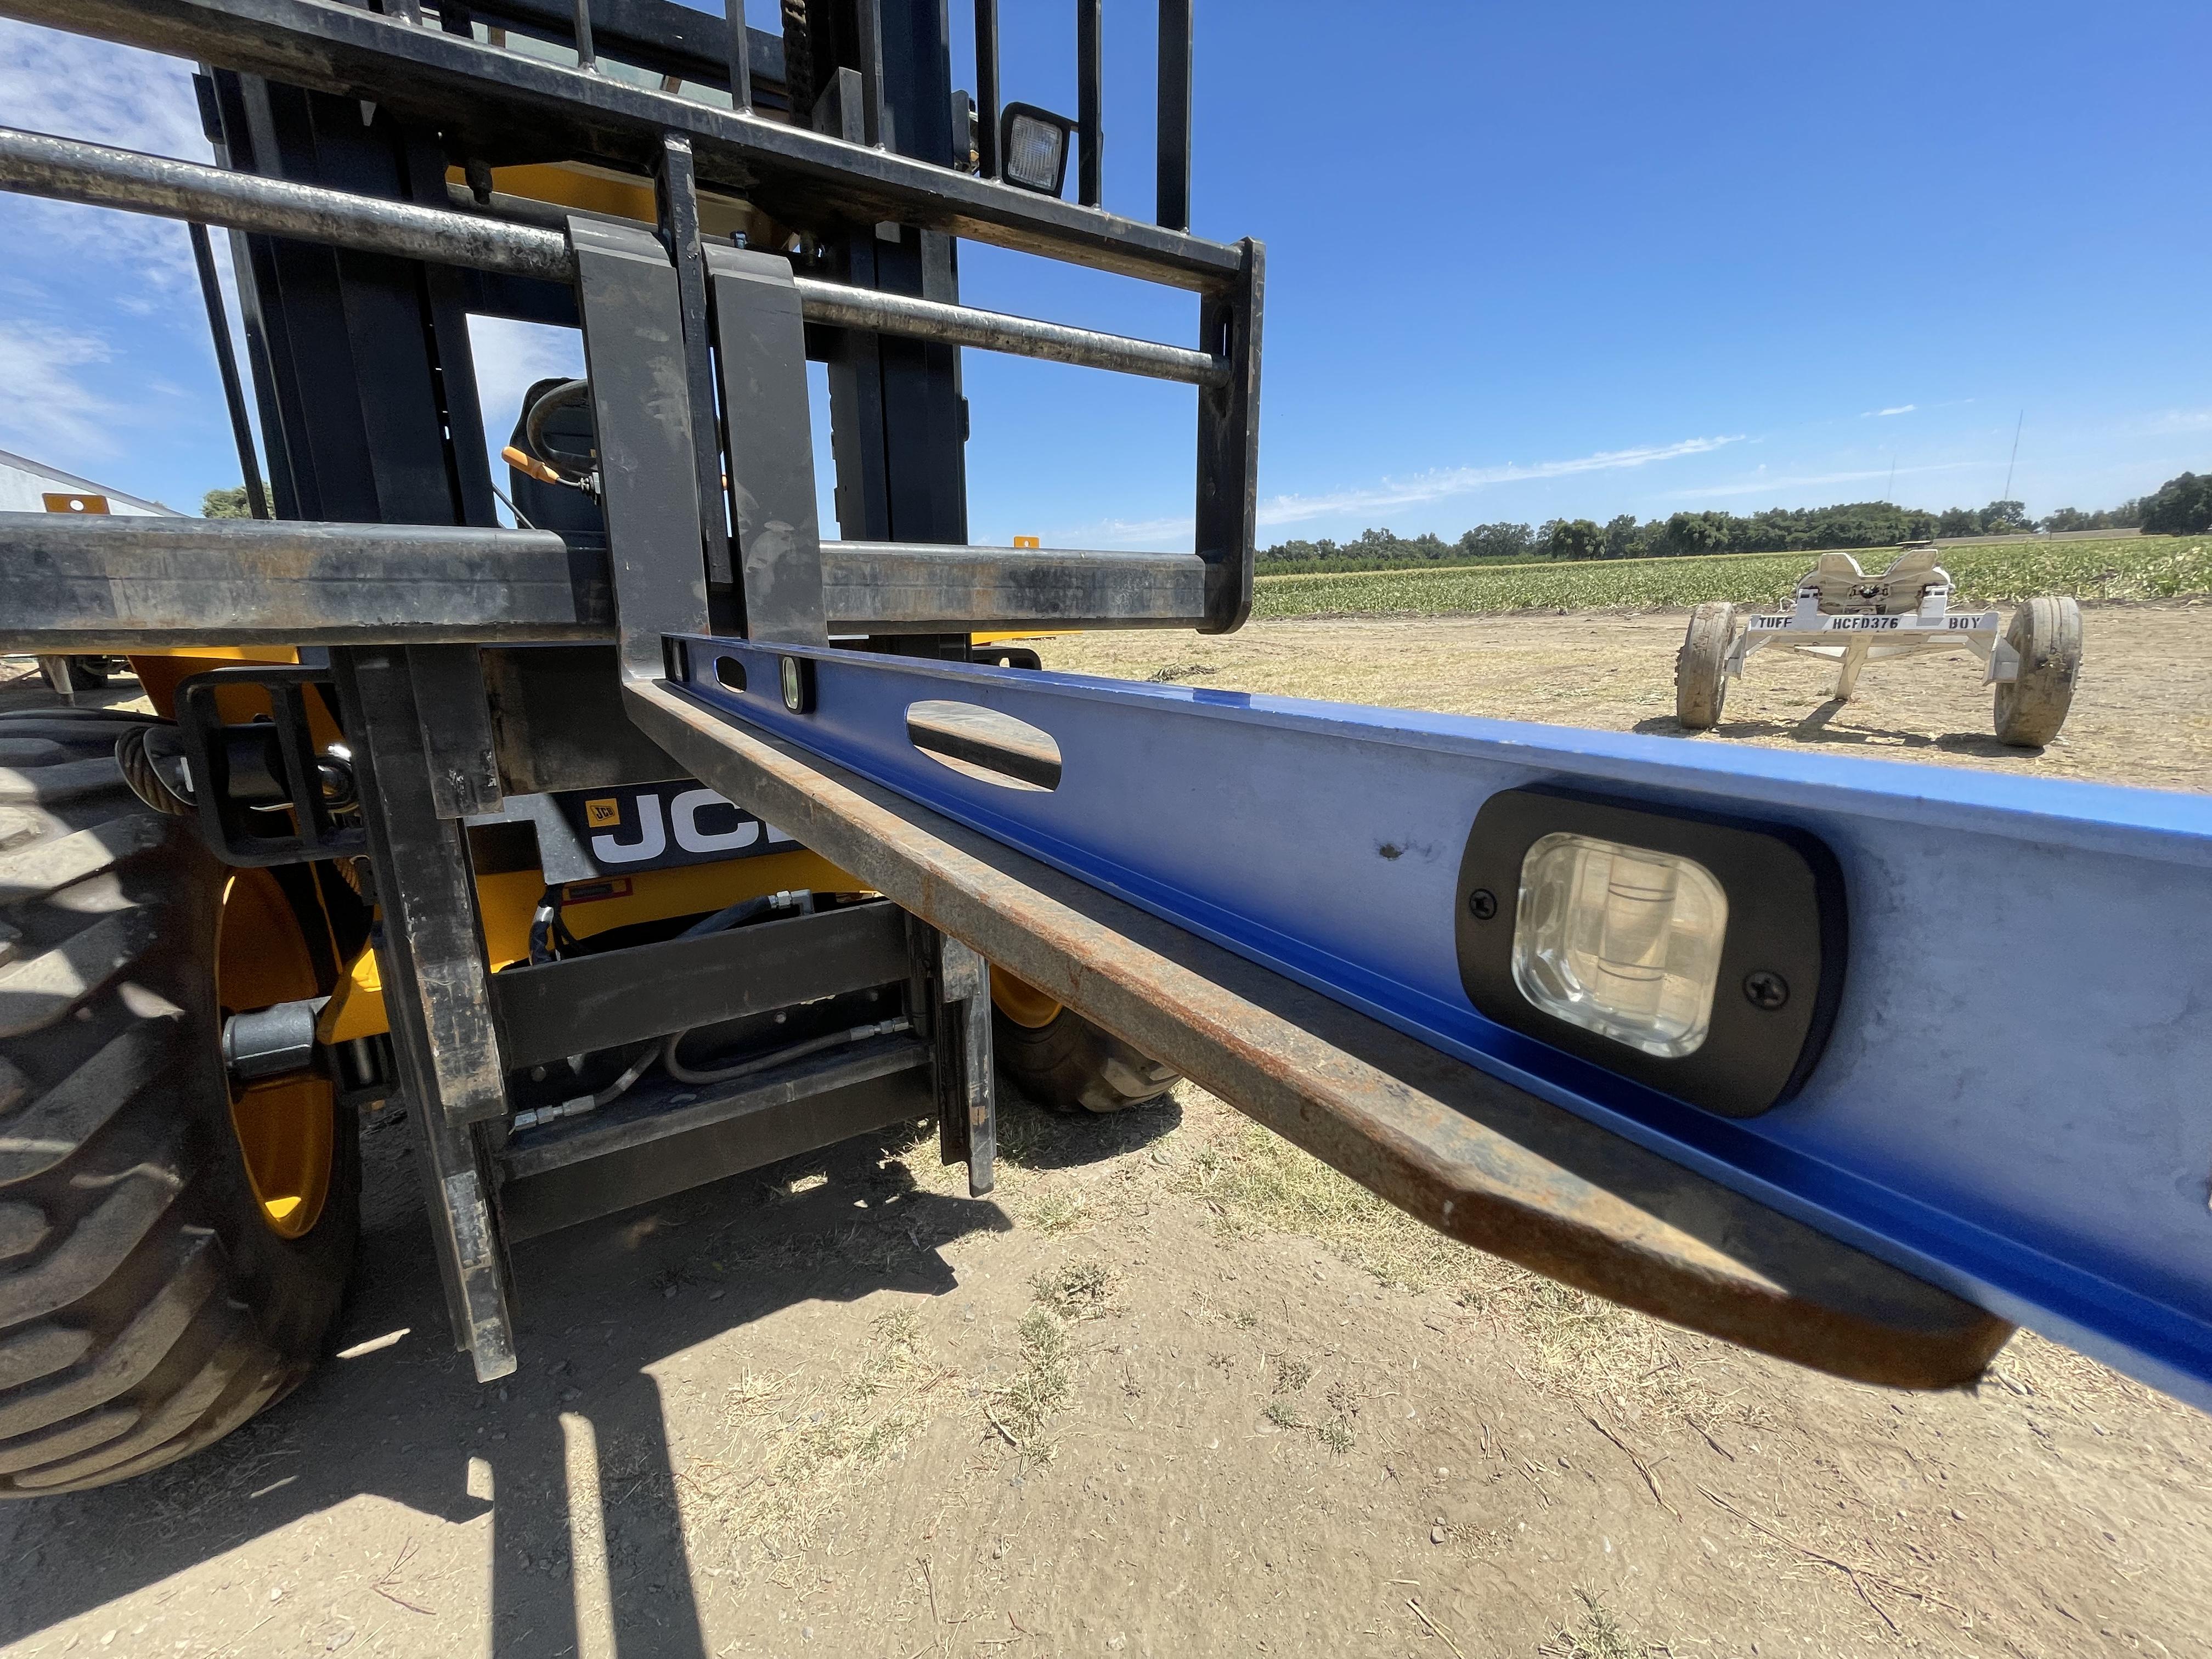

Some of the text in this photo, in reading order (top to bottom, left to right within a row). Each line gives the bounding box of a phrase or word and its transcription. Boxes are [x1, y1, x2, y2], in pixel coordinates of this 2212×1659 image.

[1759, 617, 1980, 629] TUFF HCFD376 BOY
[595, 806, 614, 820] JCB
[591, 788, 796, 863] JC
